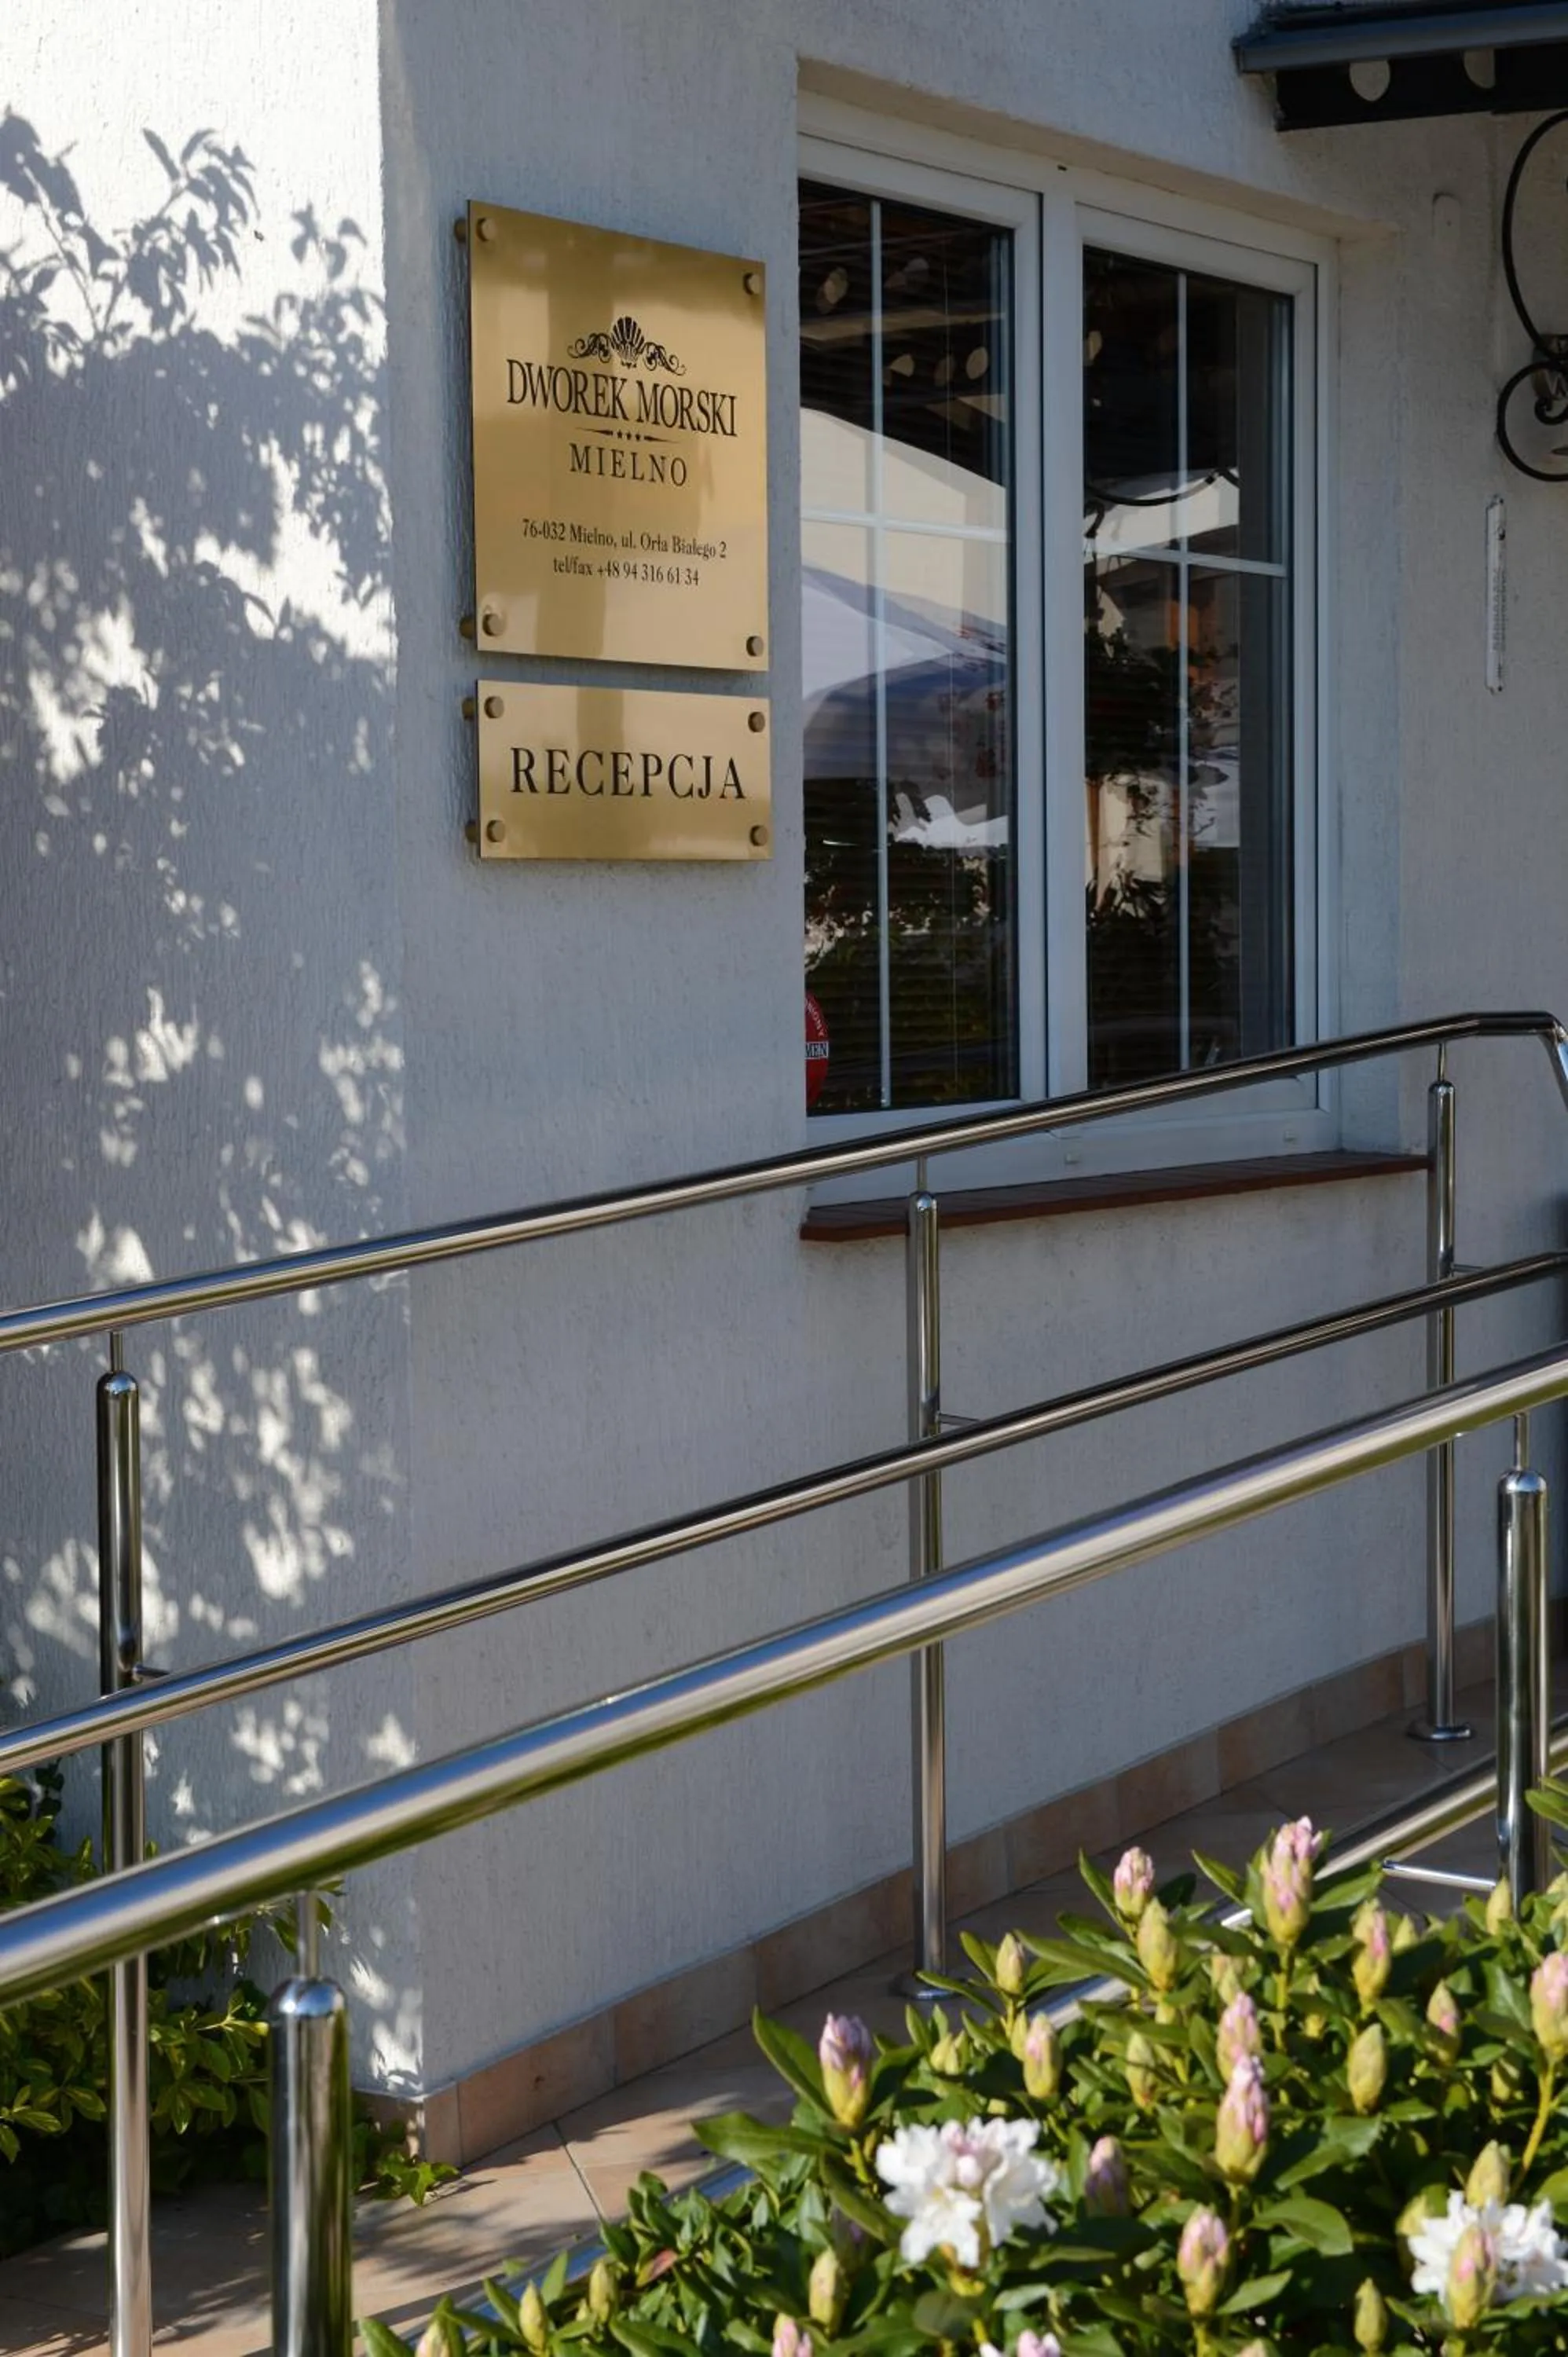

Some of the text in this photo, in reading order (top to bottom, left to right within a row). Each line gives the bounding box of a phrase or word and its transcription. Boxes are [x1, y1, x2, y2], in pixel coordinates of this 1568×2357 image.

[507, 359, 738, 437] DWOREK MORSKI
[569, 443, 687, 487] MIELNO
[522, 518, 566, 542] 76-032
[570, 523, 617, 549] Mielno,
[621, 533, 636, 550] ul.
[719, 541, 727, 559] 2
[553, 555, 699, 586] tel/fax +48 94 316 61 34
[510, 747, 746, 799] RECEPCJA
